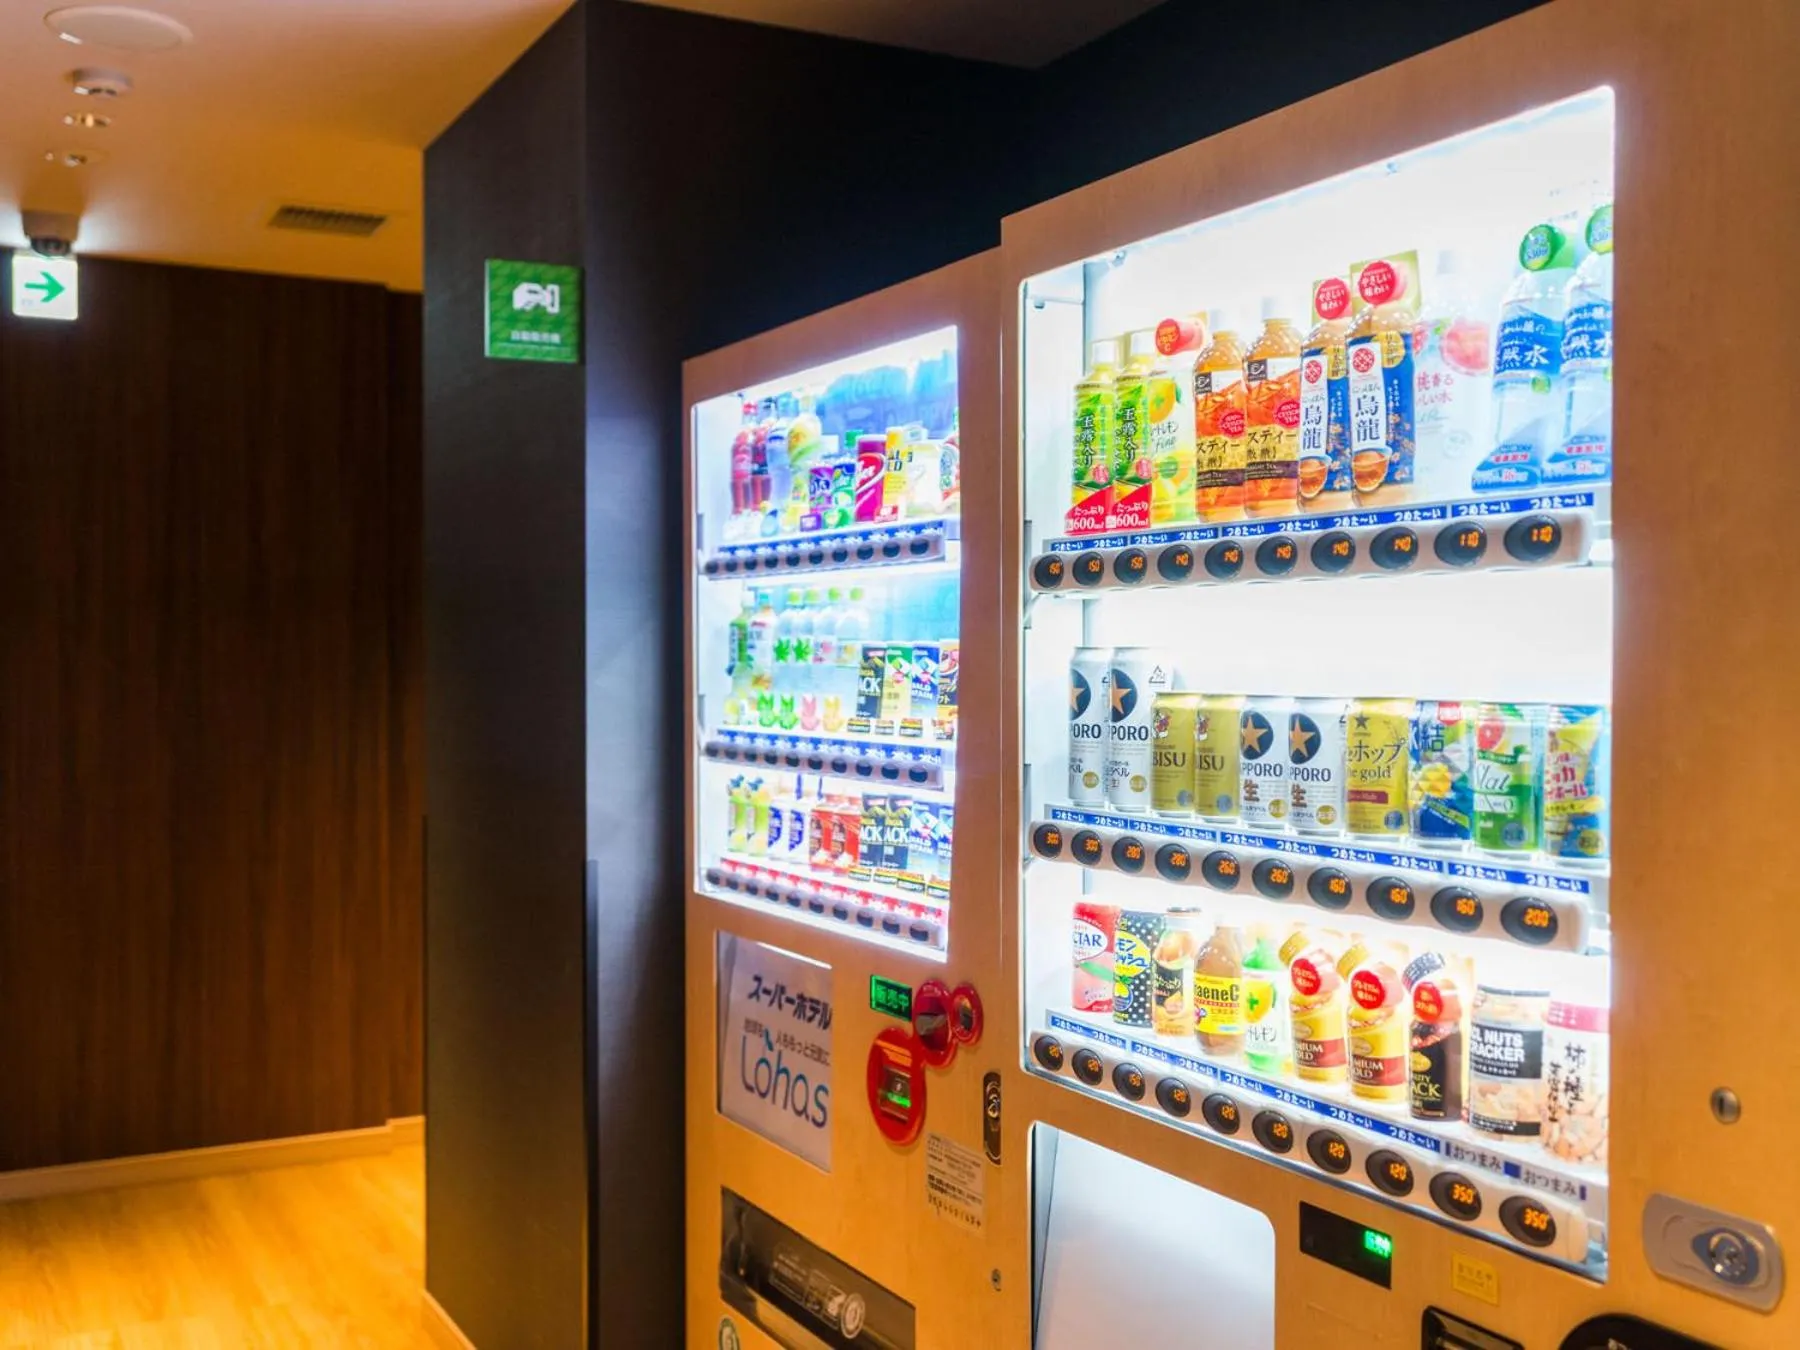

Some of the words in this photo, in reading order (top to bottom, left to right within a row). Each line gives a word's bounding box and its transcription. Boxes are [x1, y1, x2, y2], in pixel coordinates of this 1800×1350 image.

[1302, 404, 1322, 450] 烏龍
[1355, 394, 1381, 442] 烏龍
[1081, 415, 1096, 468] 玉露入り
[1122, 408, 1138, 461] 玉露入り
[1074, 505, 1105, 516] たっぷり
[1117, 501, 1148, 513] たっぷり
[1072, 518, 1105, 530] 600ml
[1116, 513, 1149, 527] 600ml
[1360, 766, 1392, 782] gold
[1243, 779, 1260, 802] 生
[1291, 784, 1308, 808] 生
[1456, 898, 1476, 916] 160
[1523, 908, 1550, 928] 200
[747, 973, 833, 1031] スーパーホテル
[1484, 1031, 1524, 1047] NUTS
[741, 1034, 830, 1129] Lohas
[1453, 1145, 1502, 1171] おつまみ
[1452, 1183, 1475, 1205] 350
[1523, 1170, 1577, 1197] おつまみ
[1524, 1207, 1549, 1231] 350
